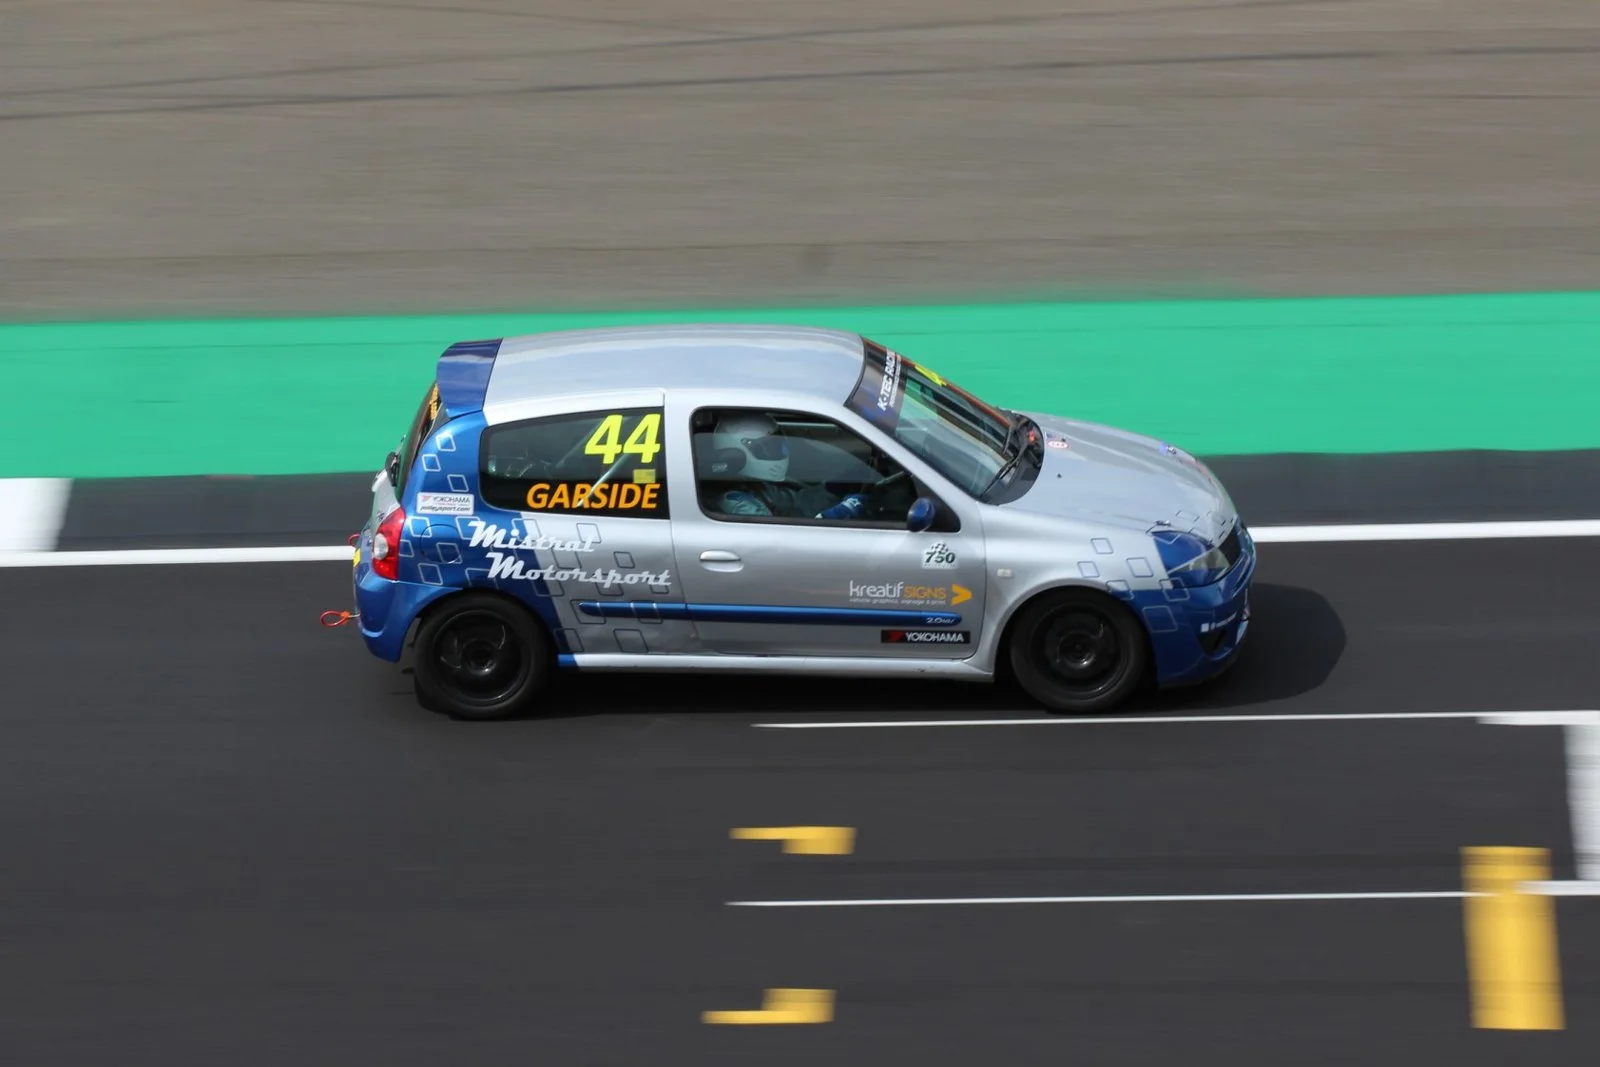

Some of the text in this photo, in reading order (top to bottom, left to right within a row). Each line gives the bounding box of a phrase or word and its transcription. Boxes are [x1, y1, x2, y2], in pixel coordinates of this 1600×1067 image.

[584, 413, 661, 464] 44
[526, 482, 661, 509] GARSIDE
[467, 520, 595, 553] Mistral
[485, 552, 671, 588] Motorsport
[925, 551, 956, 564] 750
[905, 632, 965, 642] YOKOHAMA
